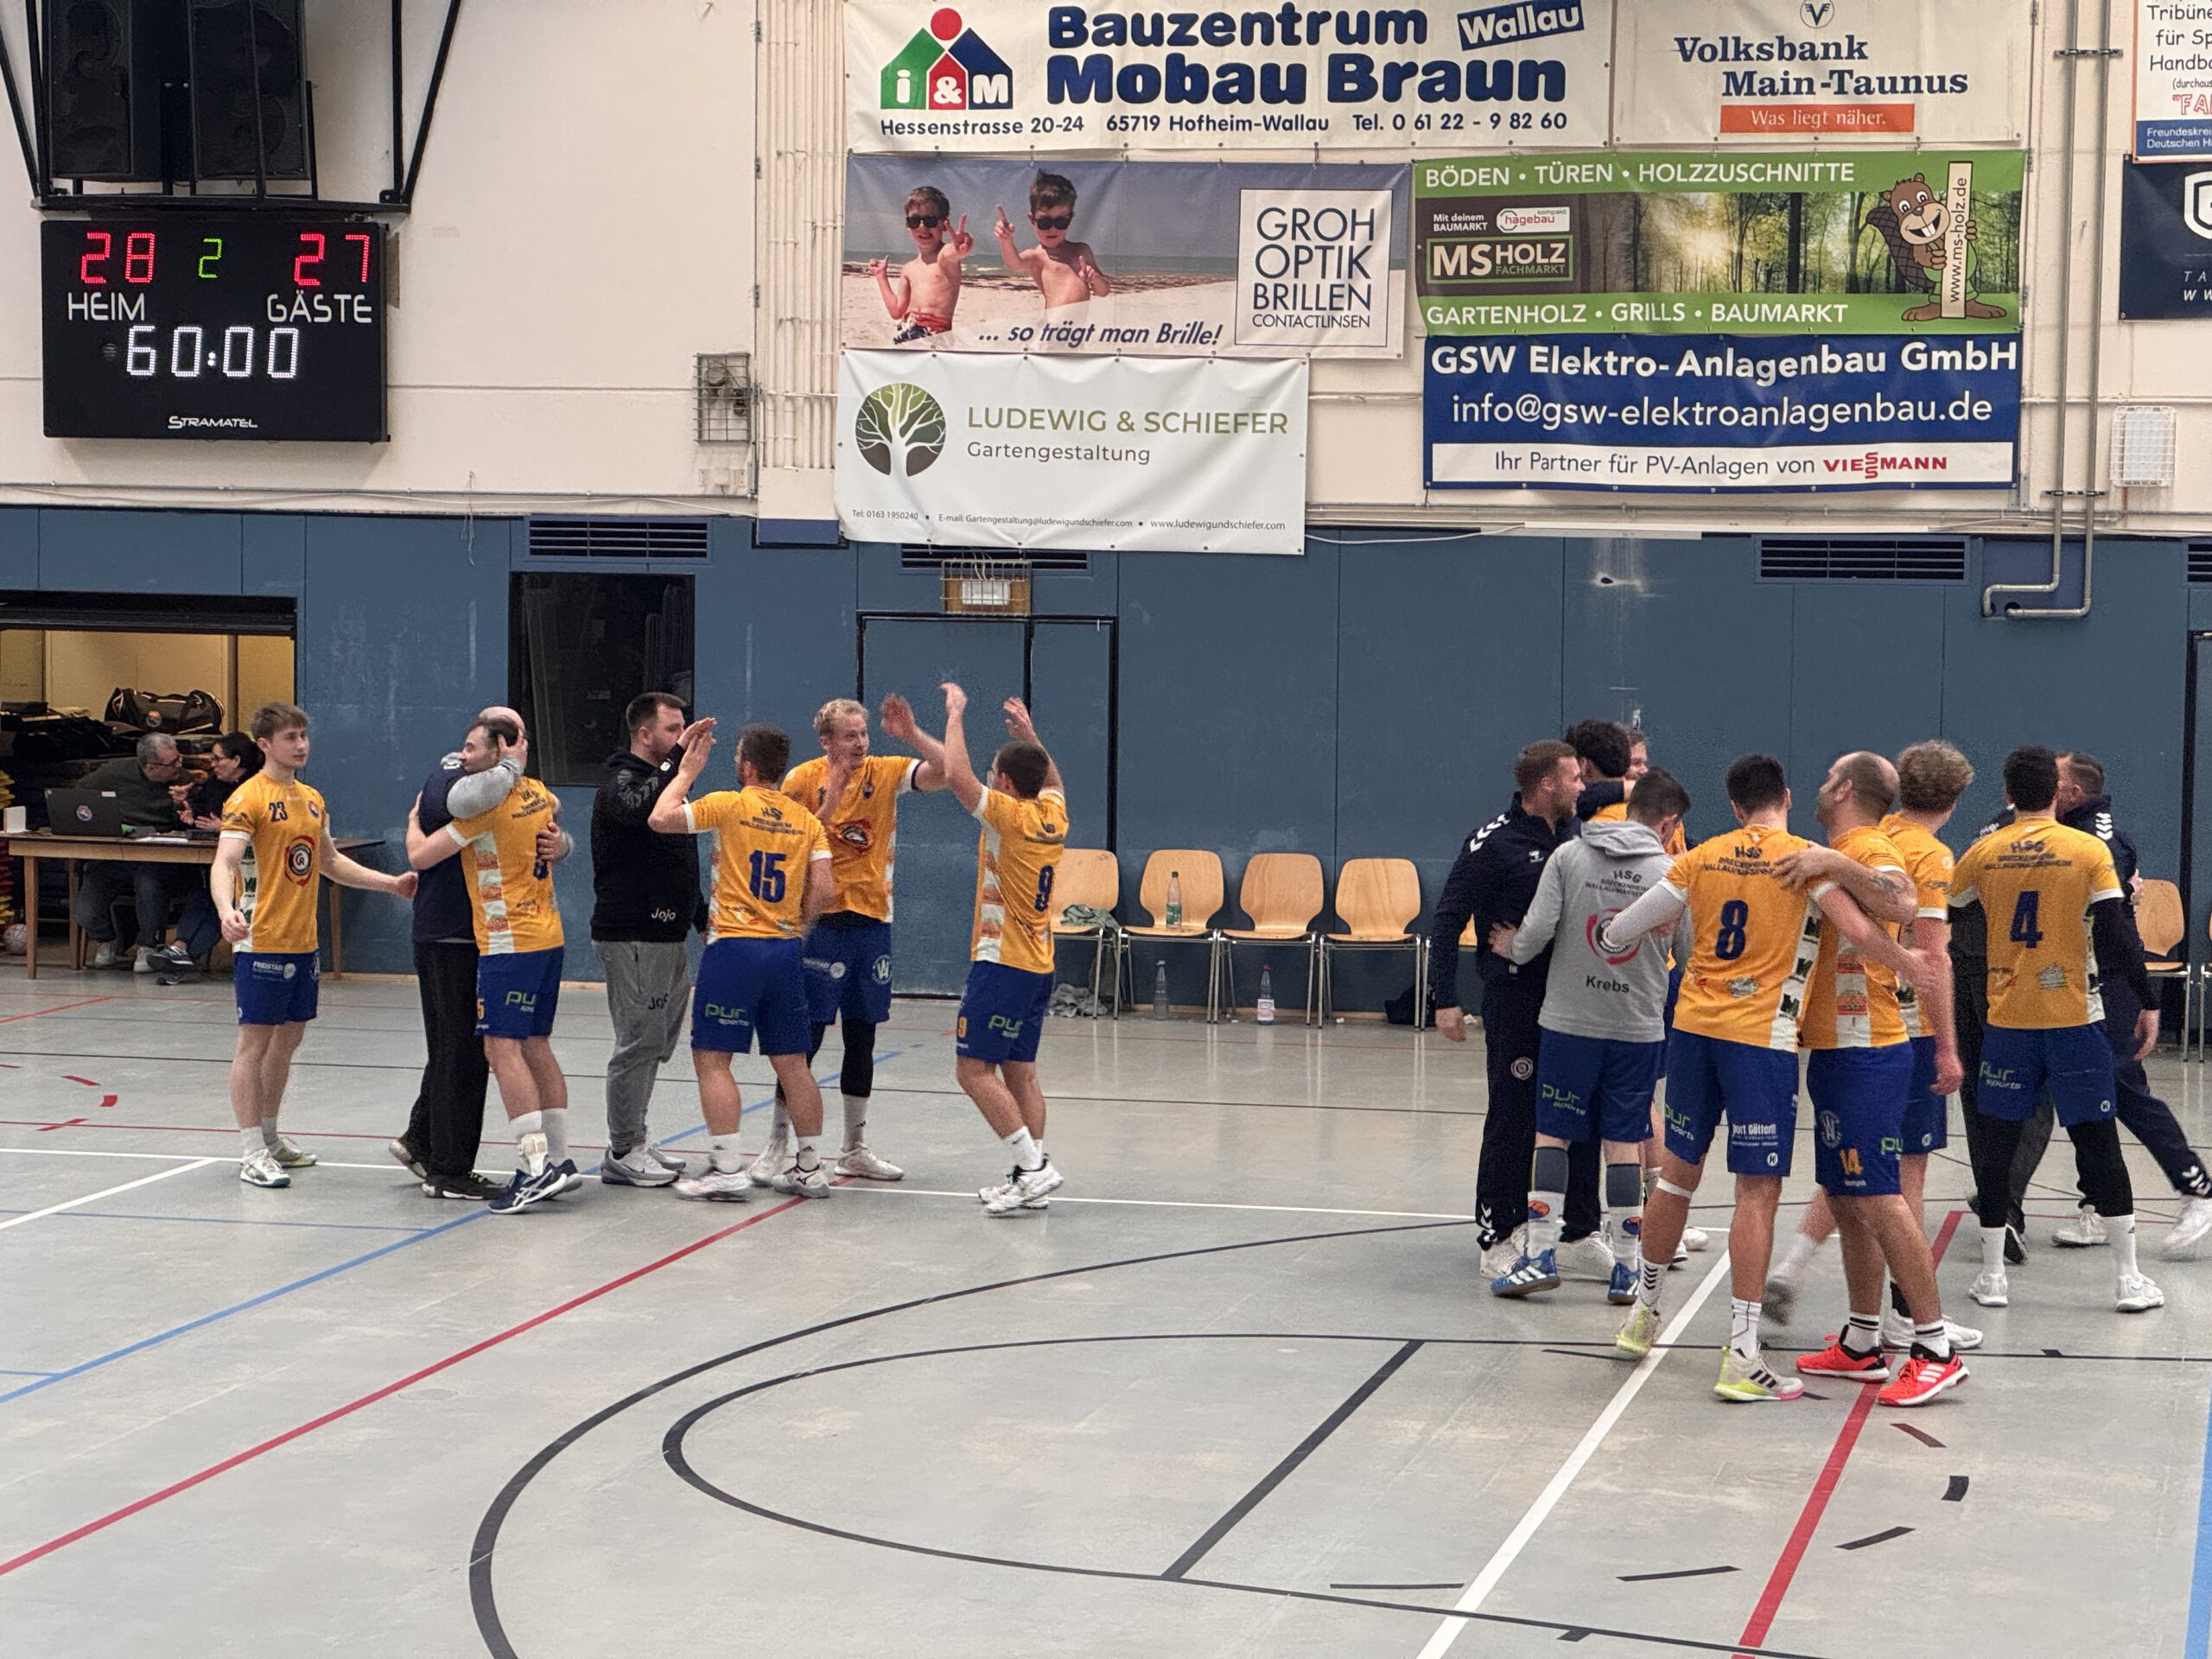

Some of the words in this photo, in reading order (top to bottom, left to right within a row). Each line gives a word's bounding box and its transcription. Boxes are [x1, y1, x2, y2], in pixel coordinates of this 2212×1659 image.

[1048, 1, 1428, 48] Bauzentrum
[1459, 3, 1580, 44] Wallau
[1674, 35, 1869, 62] Volksbank
[2155, 29, 2185, 47] für
[1047, 53, 1307, 105] Mobau
[1327, 53, 1567, 104] Braun
[1721, 69, 1969, 97] Main-Taunus
[880, 118, 1023, 136] Hessenstrasse
[1031, 115, 1084, 134] 20-24
[1106, 114, 1160, 132] 65719
[1169, 113, 1330, 133] Hofheim-Wallau
[1352, 113, 1384, 130] Tel.
[1414, 113, 1432, 130] 61
[1440, 113, 1465, 130] 22
[1509, 113, 1533, 130] 82
[1541, 112, 1567, 130] 60
[1751, 110, 1785, 125] Was
[1793, 109, 1828, 129] liegt
[1836, 110, 1886, 126] näher.
[2147, 138, 2200, 149] Deutschen
[1426, 165, 1510, 188] BÖDEN
[1535, 161, 1613, 185] TÜREN
[1638, 162, 1854, 183] HOLZZUSCHNITTE
[1256, 207, 1375, 242] GROH
[1433, 213, 1449, 222] Mit
[1452, 213, 1484, 222] deinem
[1433, 222, 1488, 232] BAUMARKT
[1505, 214, 1555, 226] hagebau
[1950, 177, 1967, 302] www.ms-holz.de
[81, 232, 156, 283] 28
[199, 238, 222, 278] 2
[294, 233, 371, 286] 27
[1255, 245, 1372, 280] OPTIK
[1496, 264, 1566, 275] FACHMARKT
[67, 292, 145, 321] HEIM
[267, 290, 372, 323] GÄSTE
[1253, 283, 1372, 312] BRILLEN
[1252, 314, 1370, 329] CONTACTLINSEN
[1427, 304, 1587, 326] GARTENHOLZ
[1611, 302, 1686, 323] GRILLS
[1711, 303, 1848, 323] BAUMARKT
[1008, 327, 1033, 341] so
[1040, 321, 1095, 347] trägt
[1101, 328, 1150, 344] man
[1156, 321, 1224, 346] Brille!
[126, 325, 299, 378] 60:00
[1431, 345, 1516, 374] GSW
[1901, 340, 2017, 371] GmbH
[168, 415, 258, 429] STRAMATEL
[968, 406, 1107, 432] LUDEWIG
[1116, 411, 1135, 433] &
[1144, 412, 1288, 435] SCHIEFER
[1452, 391, 1993, 432] info@gsw-elektroanlagenbau.de
[967, 442, 1151, 465] Gartengestaltung
[1495, 451, 1522, 470] Ihr
[1530, 452, 1601, 472] Partner
[1609, 454, 1638, 474] für
[1646, 454, 1768, 480] PV-Anlagen
[1777, 458, 1815, 474] von
[1823, 452, 1947, 480] VIESSMANN
[867, 510, 885, 518] 0163
[887, 511, 918, 519] 1950240
[938, 513, 965, 522] E-mail:
[1151, 519, 1286, 531] www.ludewigundschiefer.com
[269, 801, 288, 823] 23
[749, 849, 787, 903] 15
[1034, 865, 1054, 912] 9
[1613, 869, 1642, 883] HSG
[652, 907, 677, 922] Jojo
[2010, 891, 2044, 949] 4
[1714, 899, 1748, 961] 8
[1586, 975, 1630, 994] Krebs
[1839, 1147, 1864, 1175] 14
